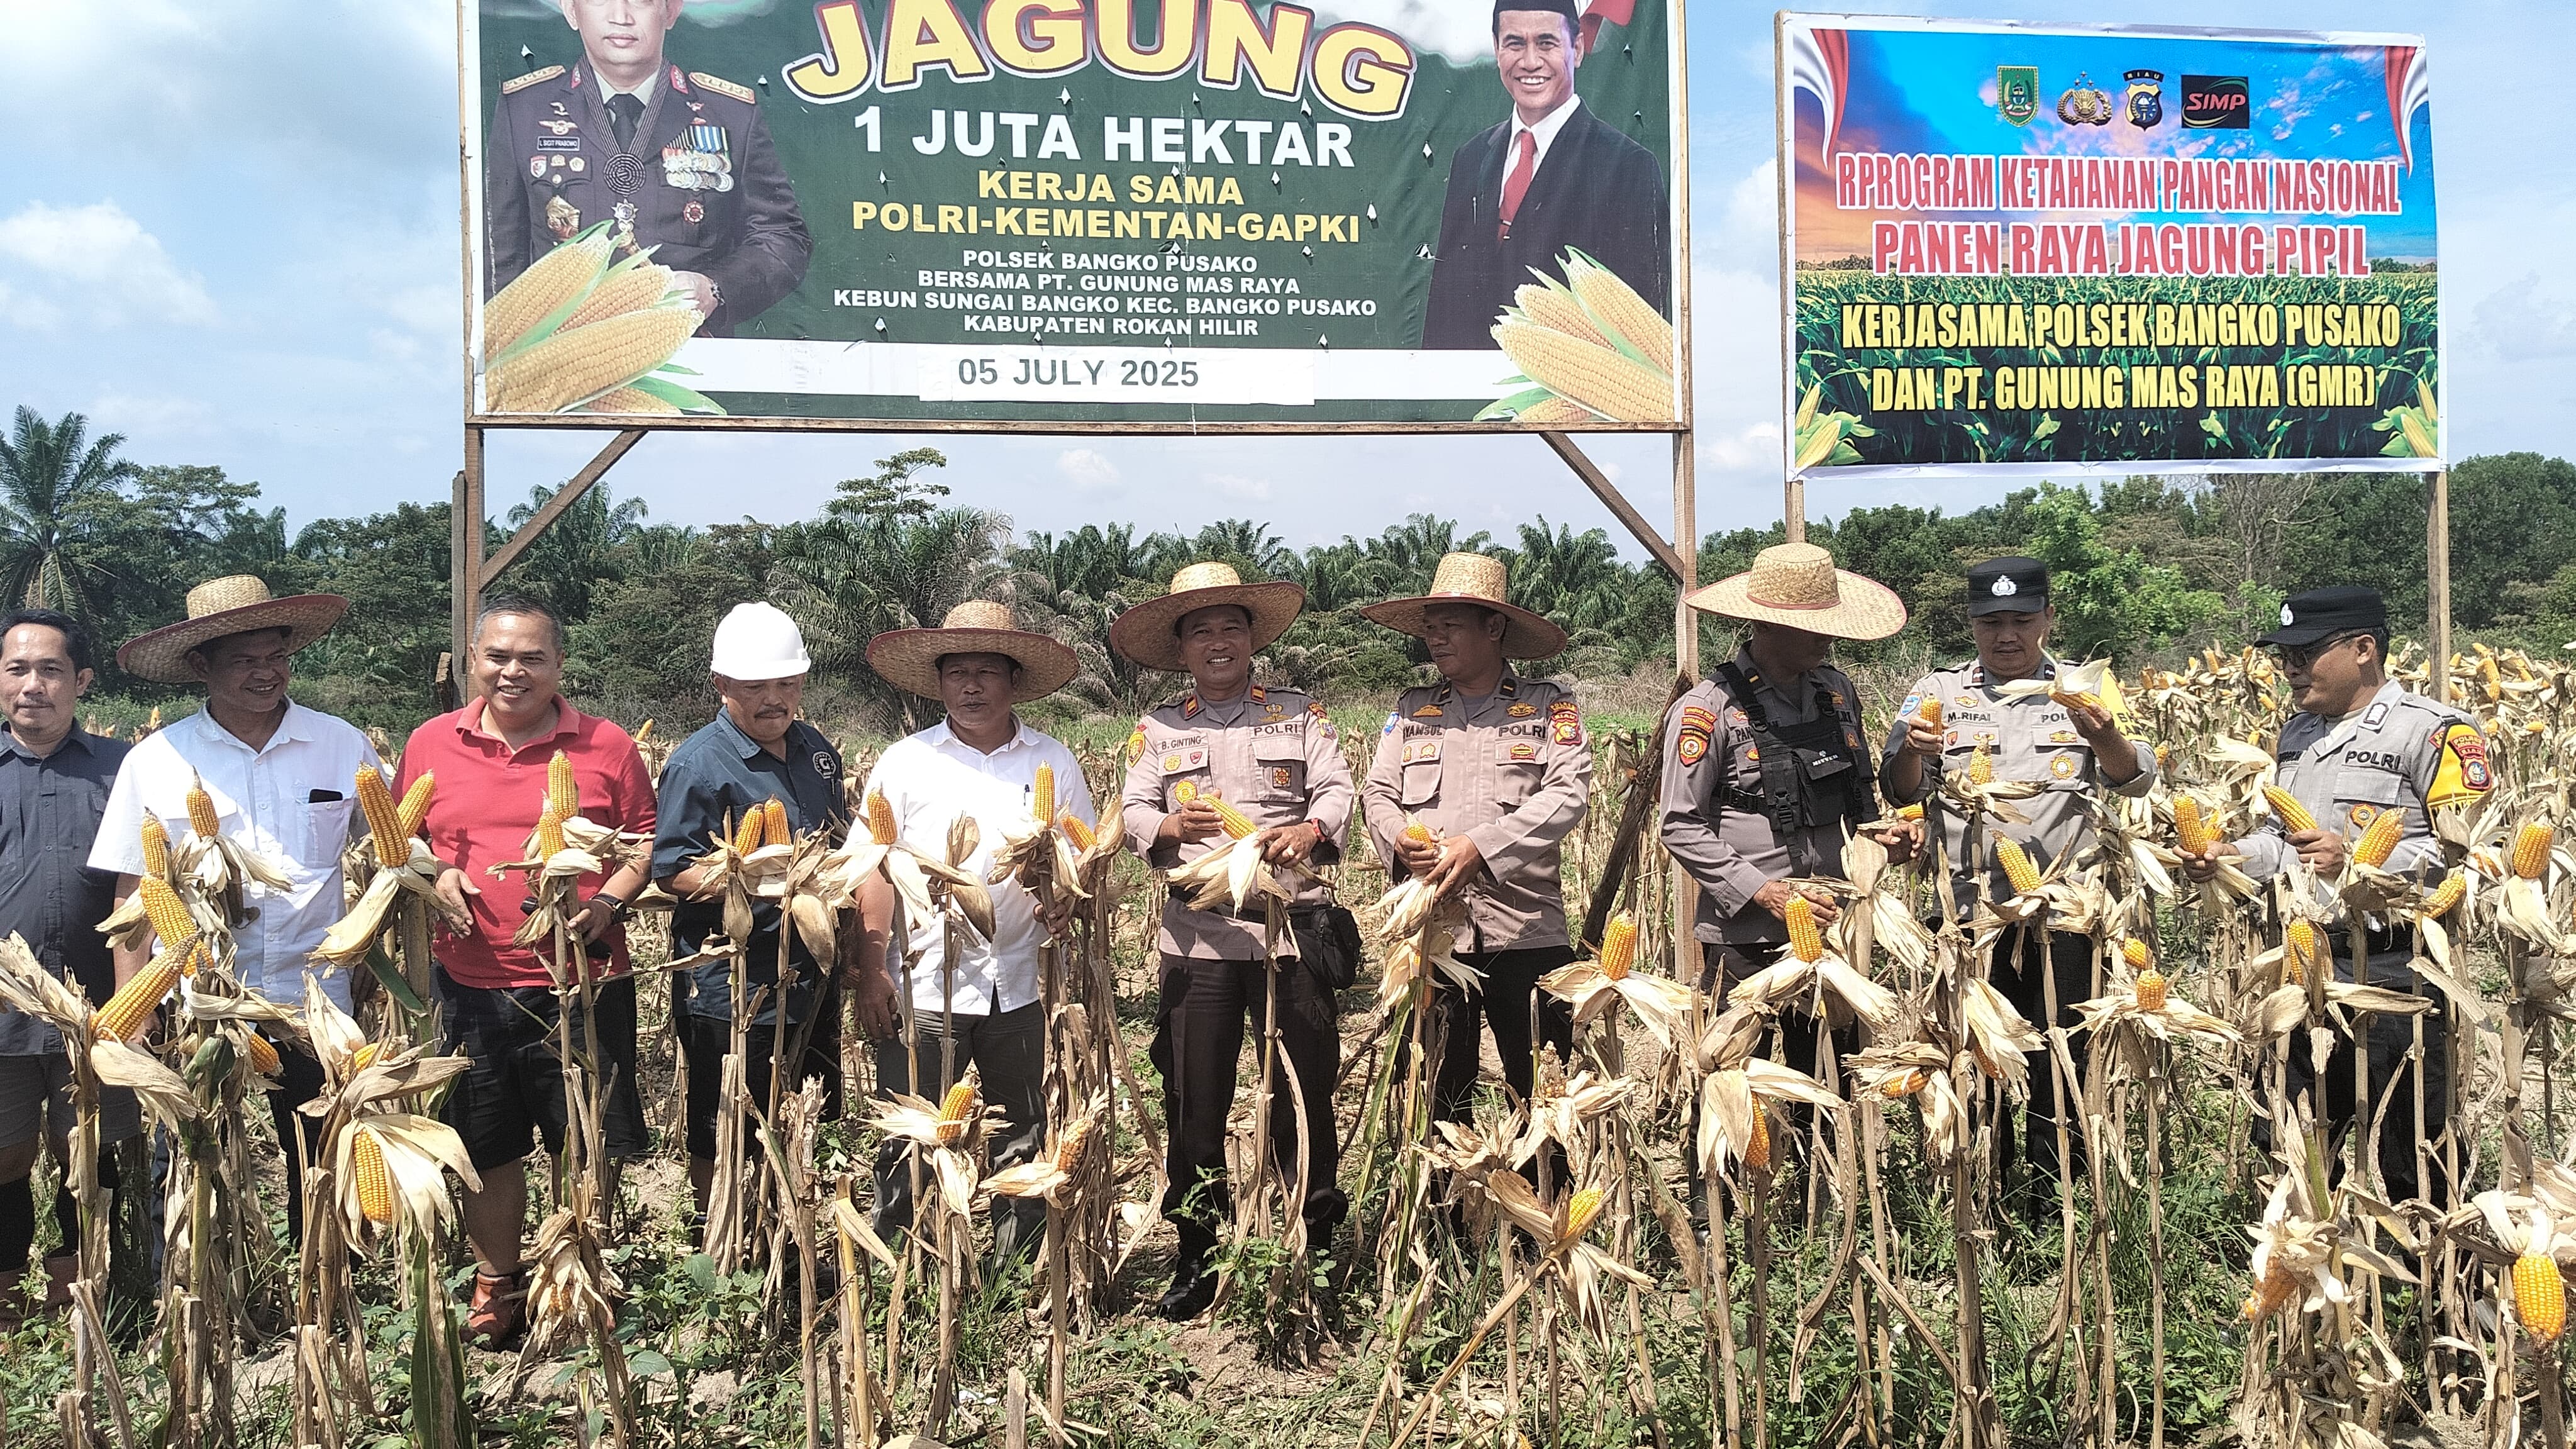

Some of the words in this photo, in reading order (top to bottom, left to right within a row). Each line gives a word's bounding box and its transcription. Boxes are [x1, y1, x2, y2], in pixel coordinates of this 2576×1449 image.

[784, 0, 1417, 121] JAGUNG
[2127, 71, 2160, 80] RIAU
[2184, 92, 2246, 111] SIMP
[855, 105, 881, 152] 1
[912, 109, 1081, 160] JUTA
[1104, 116, 1355, 167] HEKTAR
[979, 170, 1116, 202] KERJA
[1130, 175, 1245, 205] SAMA
[1837, 154, 1994, 209] RPROGRAM
[2001, 157, 2157, 210] KETAHANAN
[2162, 160, 2268, 211] PANGAN
[2274, 161, 2401, 213] NASIONAL
[852, 201, 1359, 243] POLRI-KEMENTAN-GAPKI
[963, 250, 1055, 269] POLSEK
[1062, 253, 1158, 271] BANGKO
[1166, 255, 1257, 272] PUSAKO
[1874, 223, 1999, 274] PANEN
[2011, 224, 2108, 274] RAYA
[2117, 225, 2265, 275] JAGUNG
[2275, 226, 2370, 275] PIPIL
[918, 270, 1031, 290] BERSAMA
[1038, 274, 1073, 291] PT.
[1080, 275, 1179, 292] GUNUNG
[1186, 277, 1233, 294] MAS
[1241, 277, 1301, 294] RAYA
[834, 289, 917, 308] KEBUN
[924, 292, 1014, 311] SUNGAI
[1021, 294, 1119, 313] BANGKO
[1126, 297, 1179, 314] KEC.
[1186, 297, 1280, 316] BANGKO
[1287, 299, 1377, 316] PUSAKO
[964, 314, 1105, 334] KABUPATEN
[1113, 318, 1192, 335] ROKAN
[1199, 319, 1259, 336] HILIR
[1843, 304, 2029, 348] KERJASAMA
[2034, 304, 2148, 347] POLSEK
[2157, 304, 2277, 347] BANGKO
[2285, 304, 2400, 347] PUSAKO
[958, 358, 998, 385] 05
[1013, 358, 1105, 386] JULY
[1121, 360, 1199, 387] 2025
[1872, 367, 1937, 411] DAN
[1943, 367, 1987, 410] PT.
[1995, 366, 2124, 410] GUNUNG
[2131, 365, 2198, 409] MAS
[2206, 365, 2280, 408] RAYA
[2287, 365, 2375, 408] (GMR)
[1170, 736, 1202, 749] GINTING
[1253, 723, 1298, 736] POLRI
[1498, 723, 1546, 739] POLRI
[2345, 750, 2400, 770] POLRI
